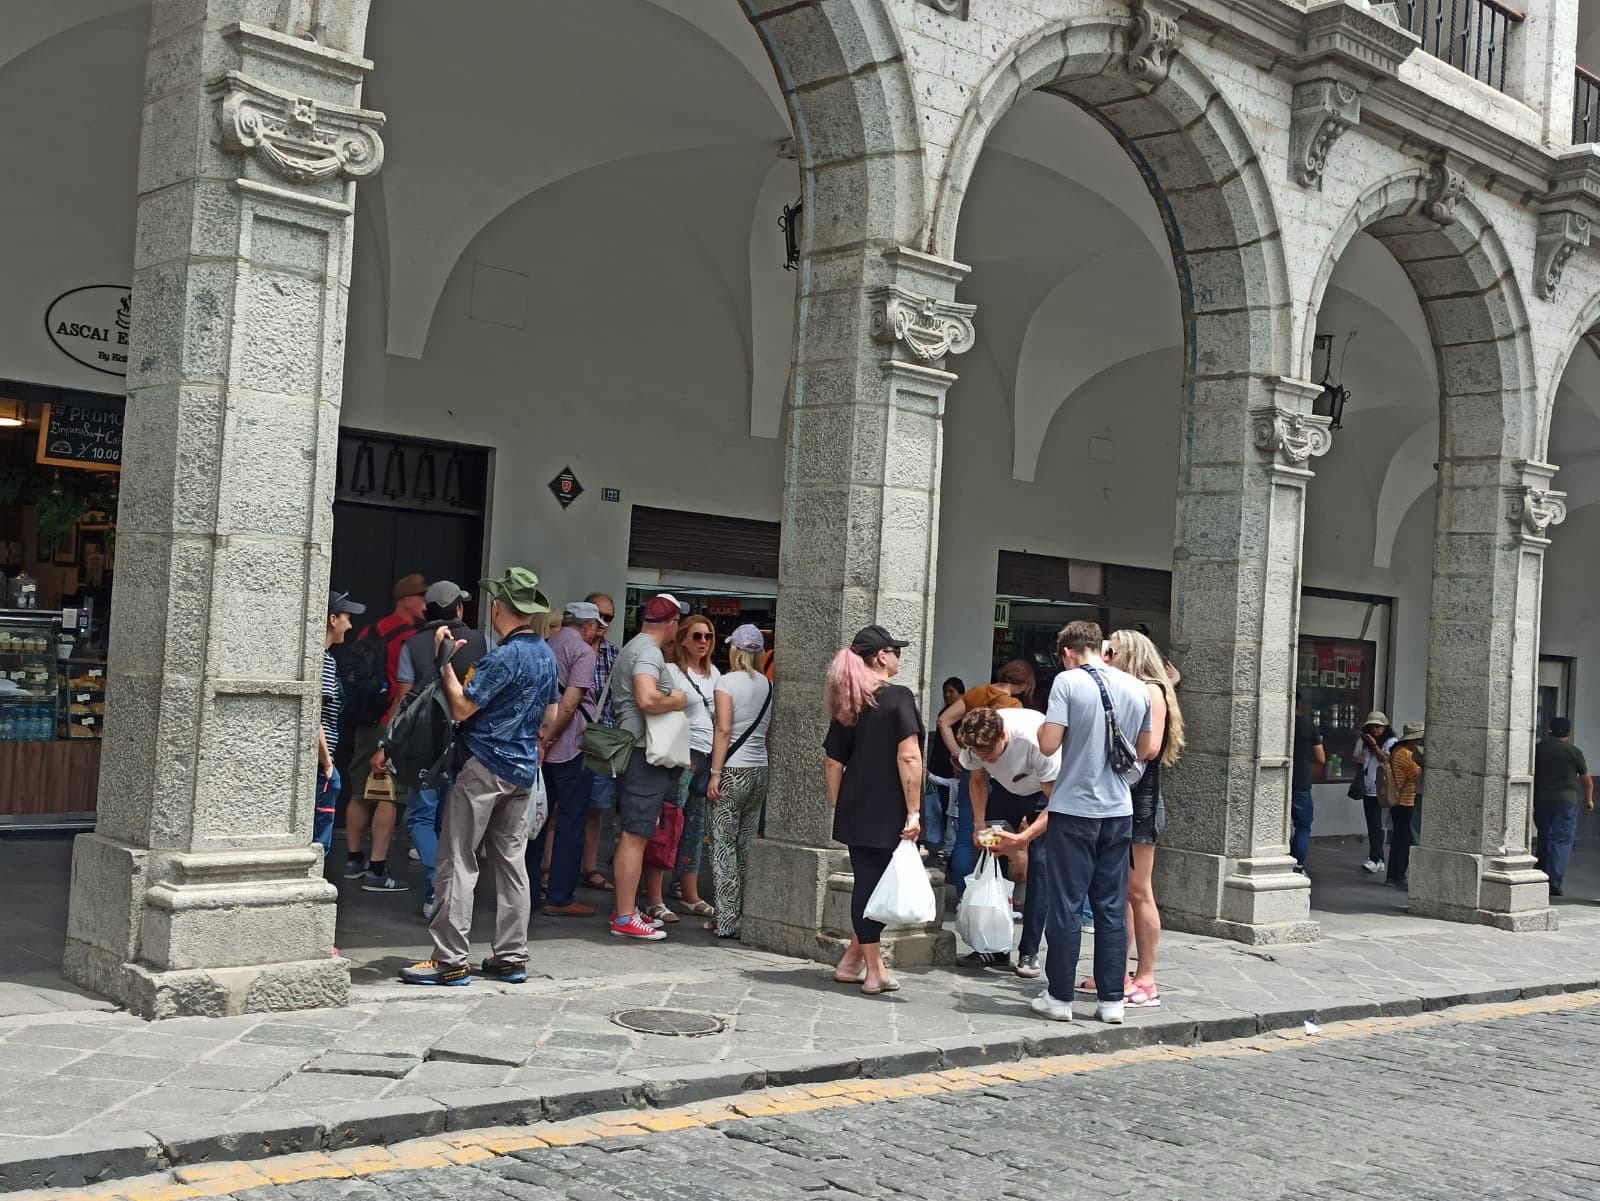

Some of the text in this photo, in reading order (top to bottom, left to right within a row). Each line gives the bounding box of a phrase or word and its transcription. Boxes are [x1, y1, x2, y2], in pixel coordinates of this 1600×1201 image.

[56, 321, 130, 345] ASCAI E
[98, 351, 110, 361] By
